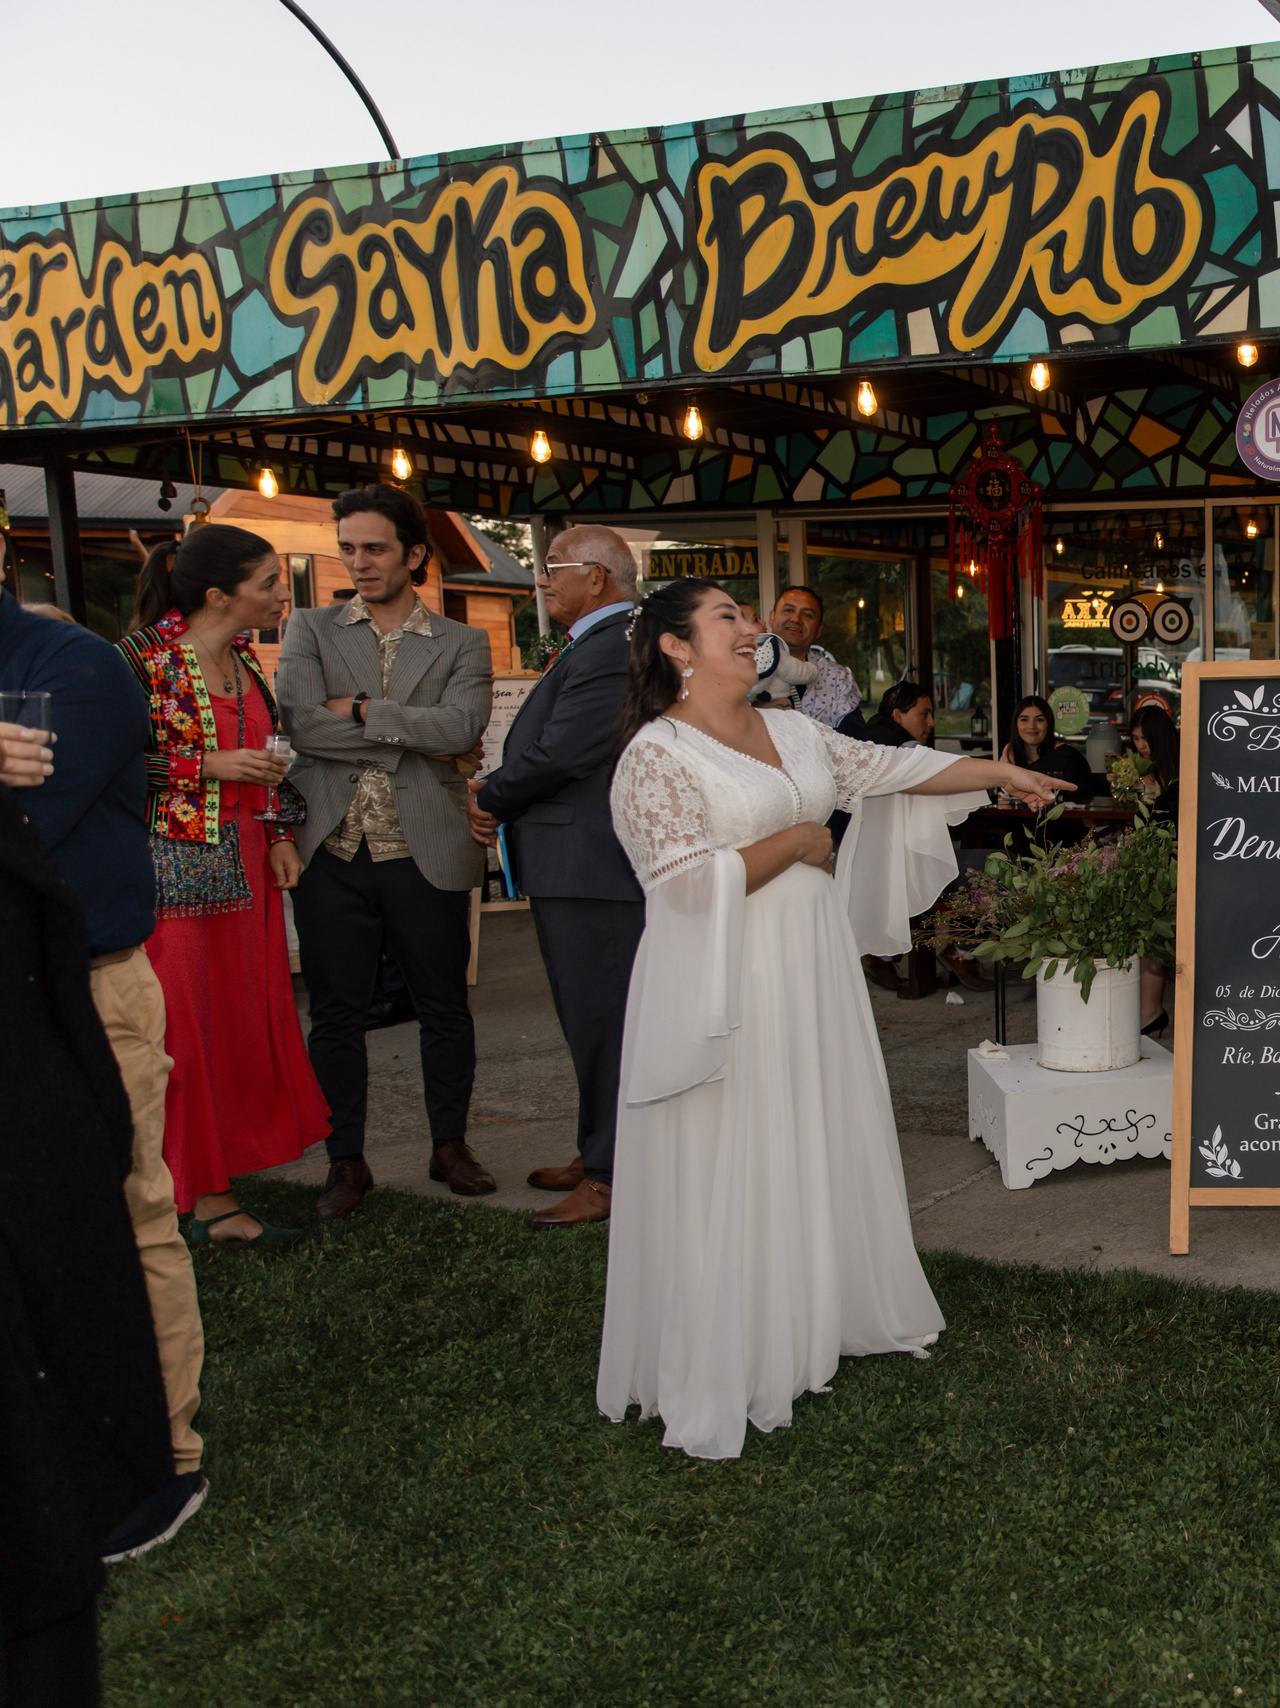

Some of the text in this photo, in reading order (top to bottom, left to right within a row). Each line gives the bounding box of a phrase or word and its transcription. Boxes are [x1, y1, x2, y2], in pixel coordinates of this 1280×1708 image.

[705, 151, 999, 353] Brew
[962, 113, 1188, 339] Pub
[1244, 388, 1275, 419] Helados
[985, 479, 1003, 497] 福
[648, 551, 757, 577] ENTRADA
[1215, 985, 1231, 998] 05
[1239, 985, 1255, 998] de
[1221, 1046, 1255, 1066] Ríe,
